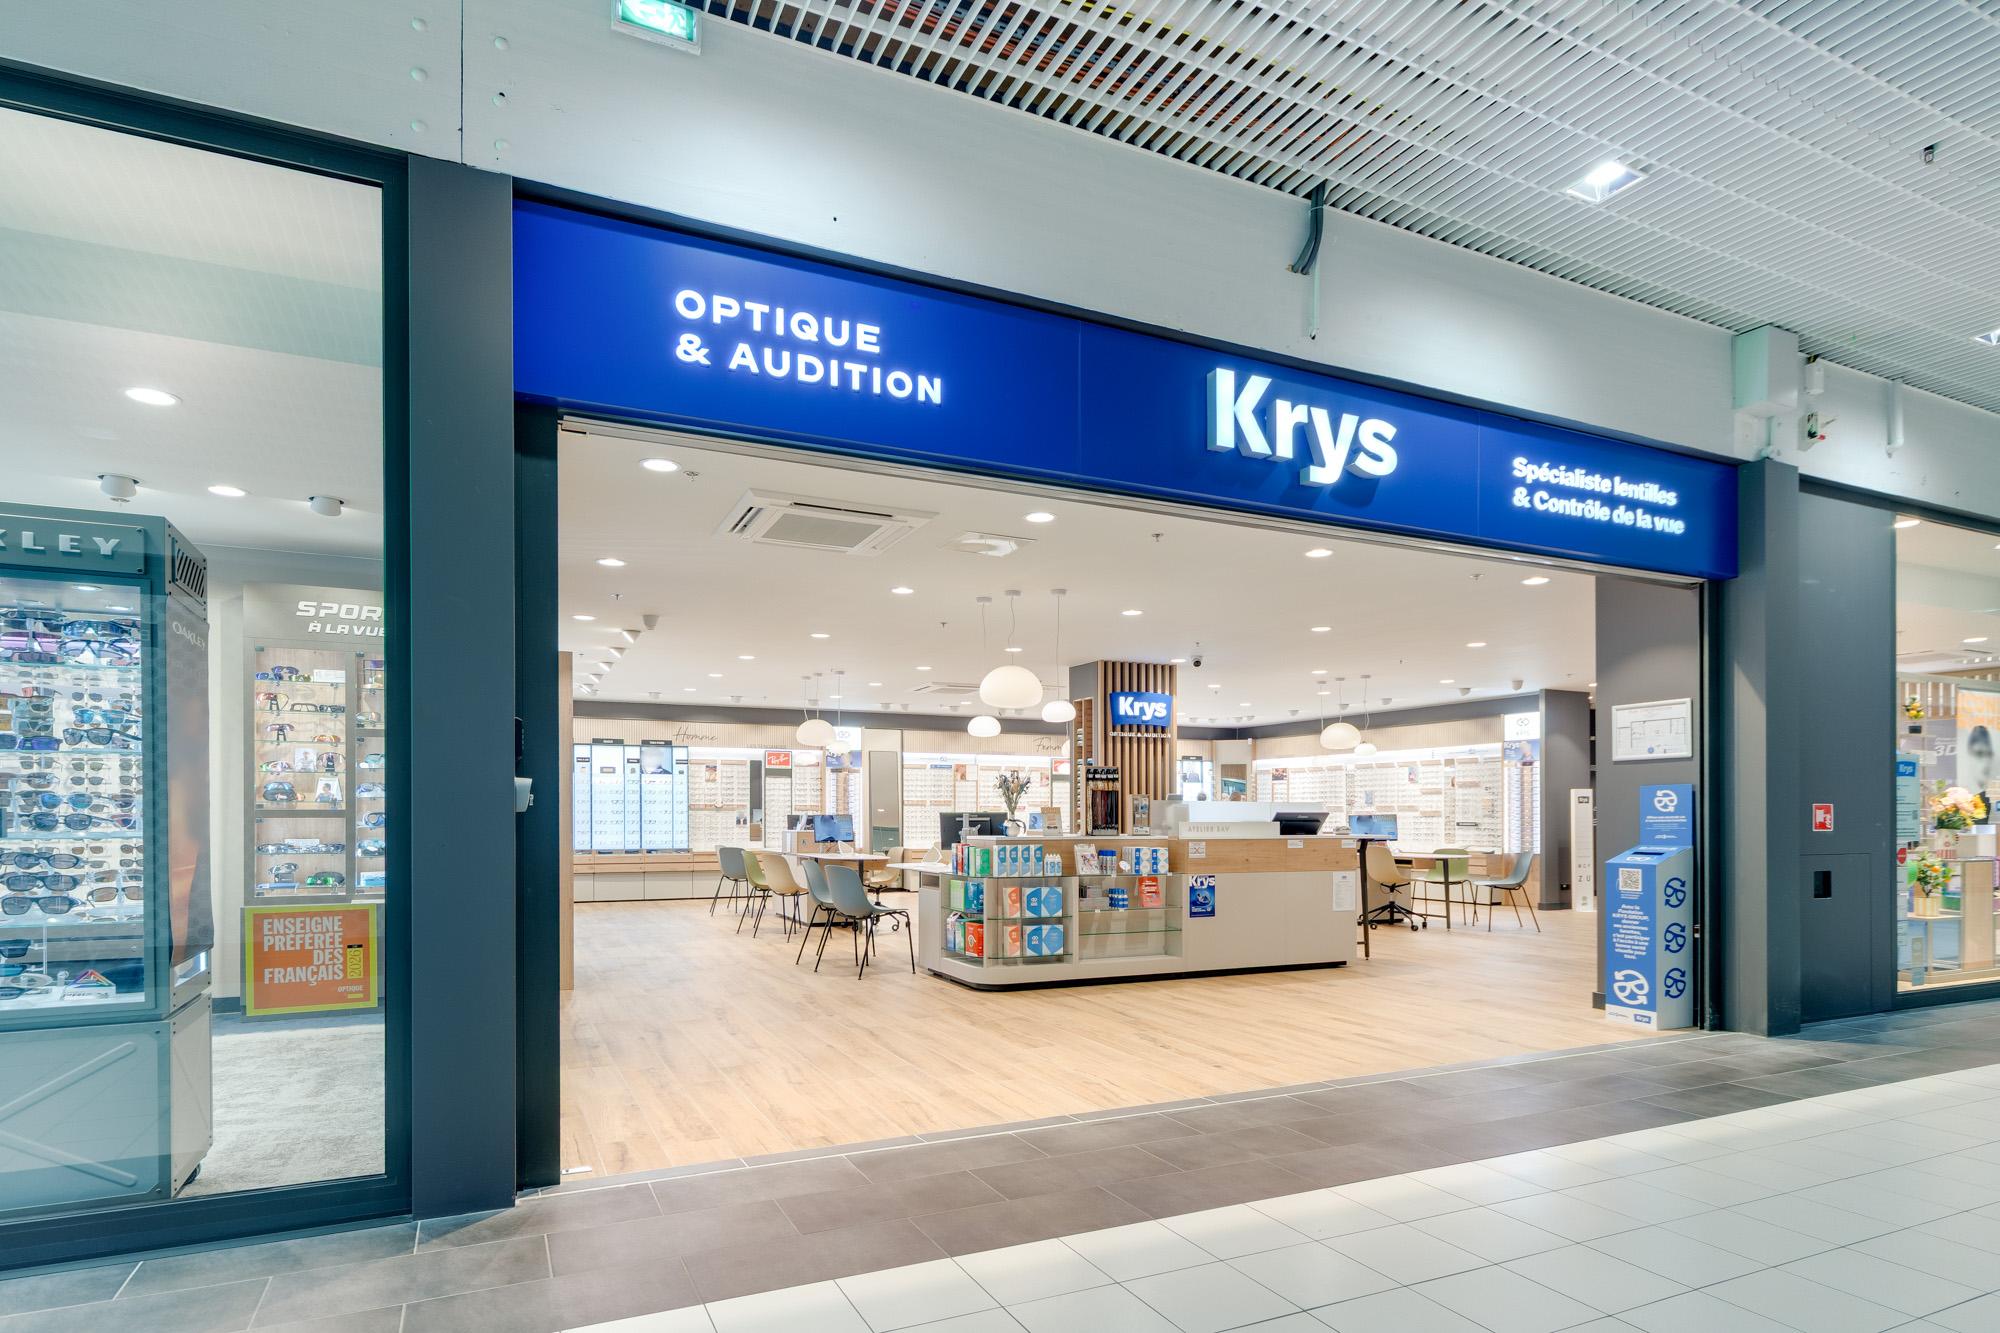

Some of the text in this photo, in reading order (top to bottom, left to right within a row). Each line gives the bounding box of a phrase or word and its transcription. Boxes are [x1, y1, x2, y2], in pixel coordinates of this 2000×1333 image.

[674, 289, 881, 354] OPTIQUE
[674, 333, 943, 405] & AUDITION
[1207, 367, 1399, 487] Krys
[1512, 456, 1678, 506] Spécialiste lentilles
[1512, 486, 1686, 535] & Contrôle de la vue
[0, 529, 120, 555] LEY
[296, 600, 383, 621] SPOR
[308, 620, 321, 633] À
[325, 623, 350, 635] LA
[1118, 695, 1167, 721] Krys
[672, 725, 718, 743] Homme
[1189, 875, 1216, 889] Krys
[263, 916, 344, 934] ENSEIGNE
[313, 949, 344, 965] DES
[264, 964, 344, 986] FRANÇAIS
